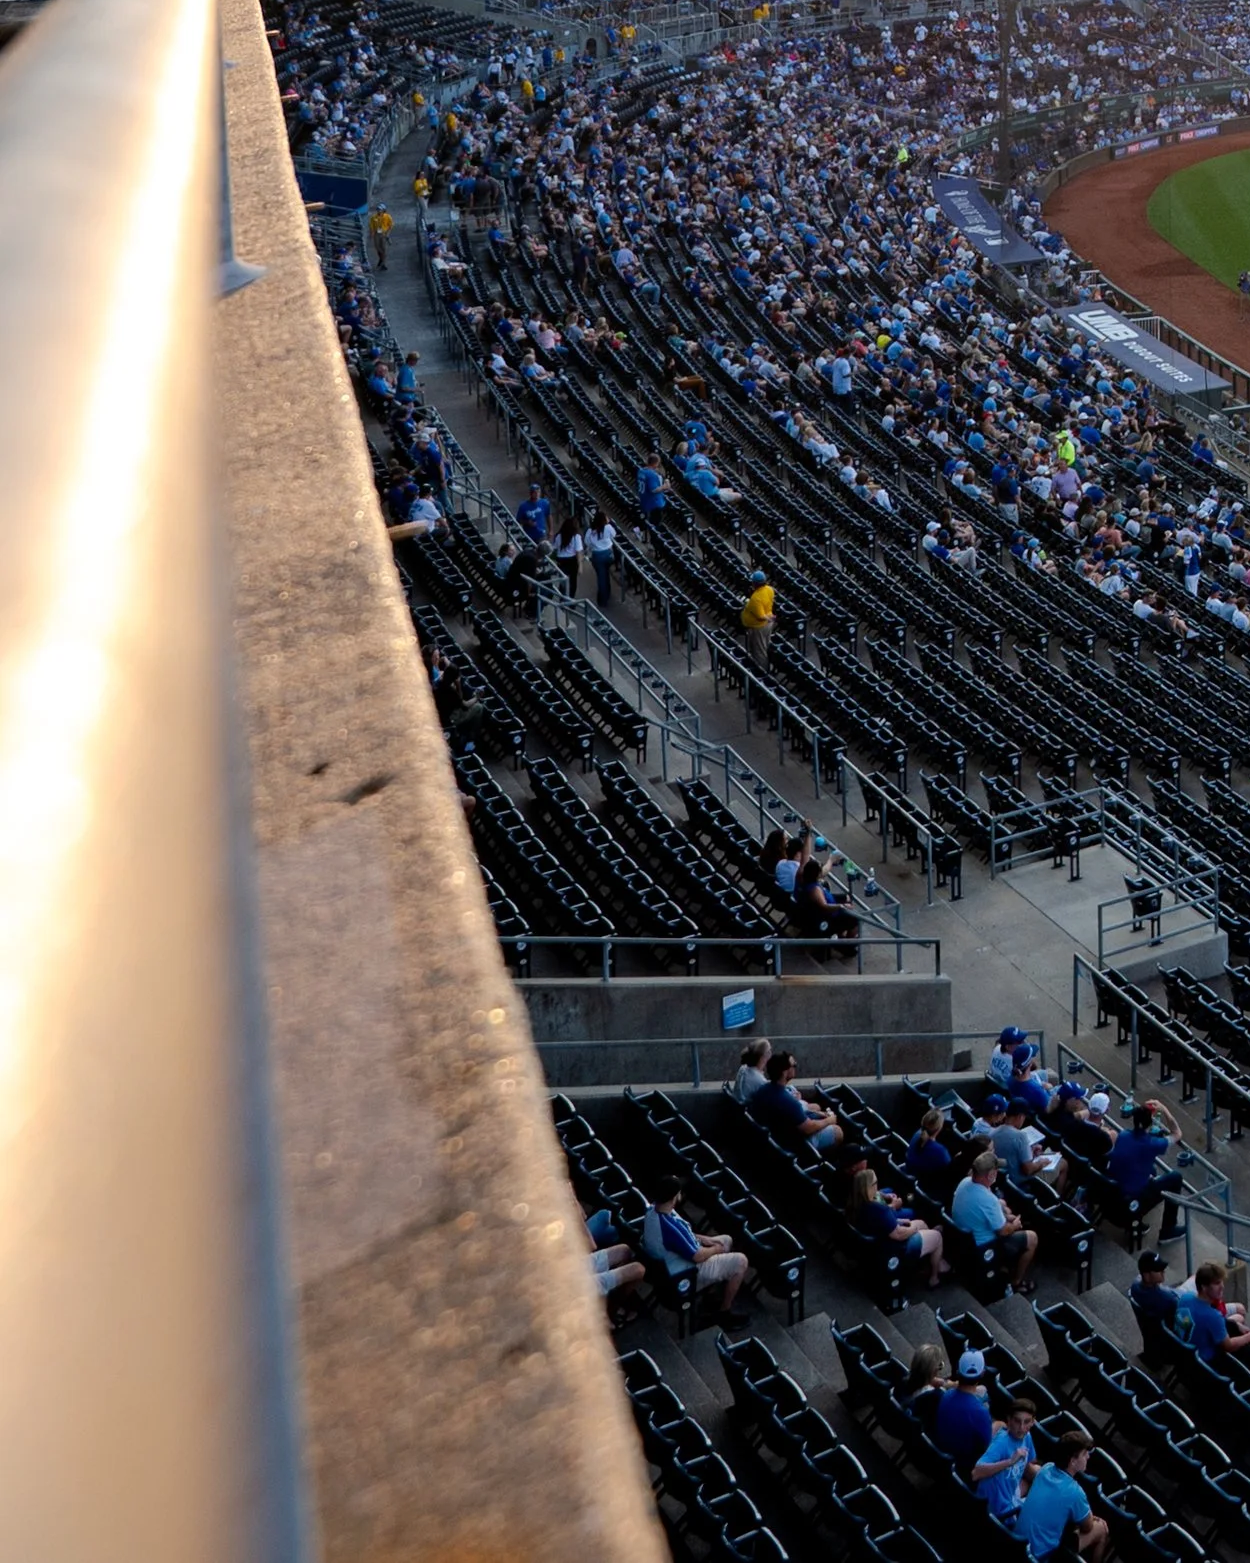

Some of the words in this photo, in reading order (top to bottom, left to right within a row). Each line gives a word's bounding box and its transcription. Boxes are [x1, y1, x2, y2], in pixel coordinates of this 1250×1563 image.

[1078, 309, 1140, 342] UMB
[1123, 341, 1163, 364] DUGOUT
[1156, 362, 1193, 383] SUITES
